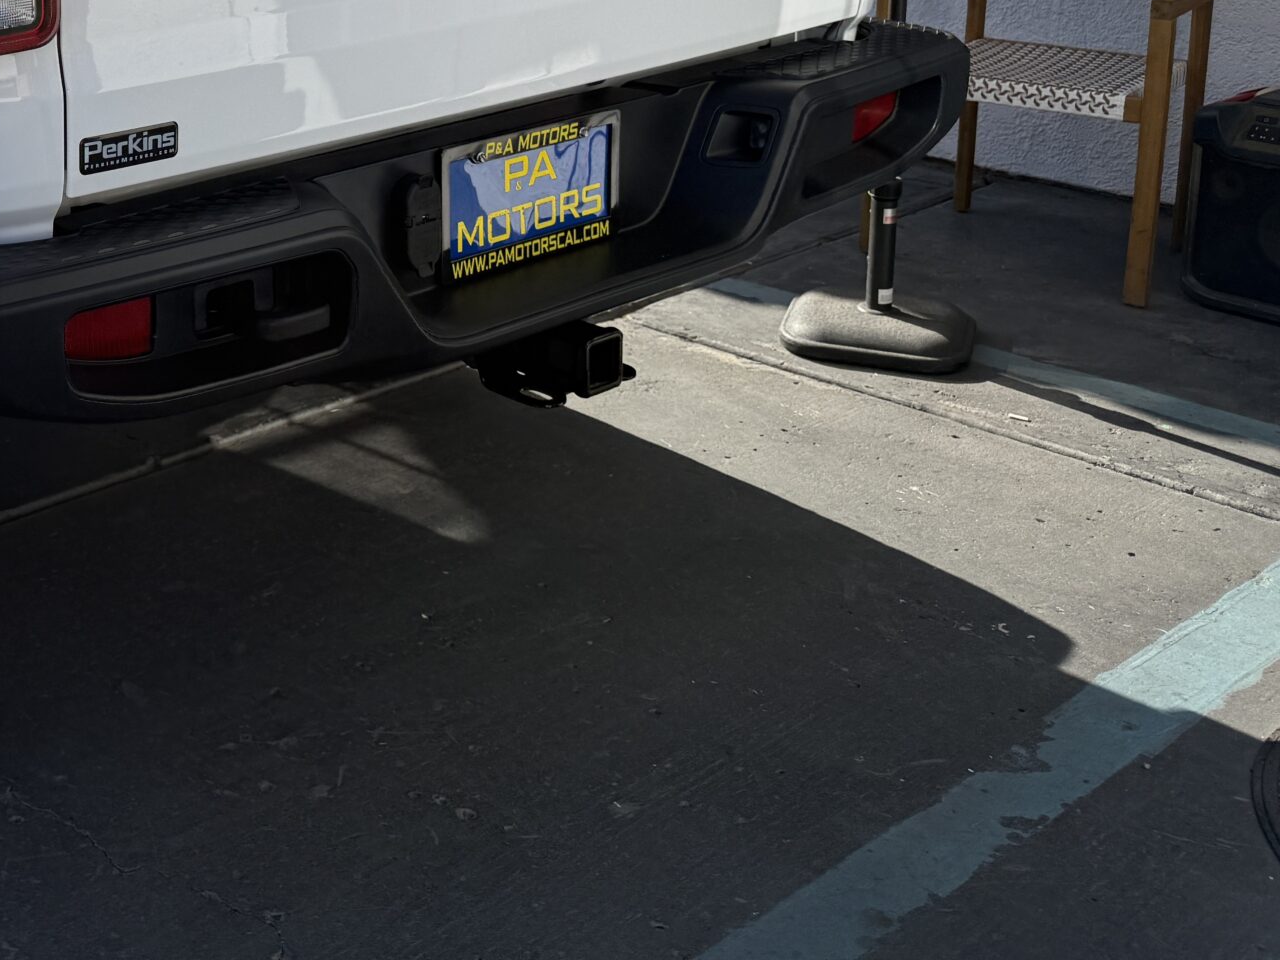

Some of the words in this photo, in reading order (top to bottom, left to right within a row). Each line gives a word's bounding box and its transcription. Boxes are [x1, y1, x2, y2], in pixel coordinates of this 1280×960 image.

[84, 131, 175, 164] Perkins
[485, 138, 514, 158] P&A
[518, 122, 579, 153] MOTORS
[457, 183, 603, 253] MOTORS
[452, 220, 610, 279] WWW.PAMOTORSCAL.COM
